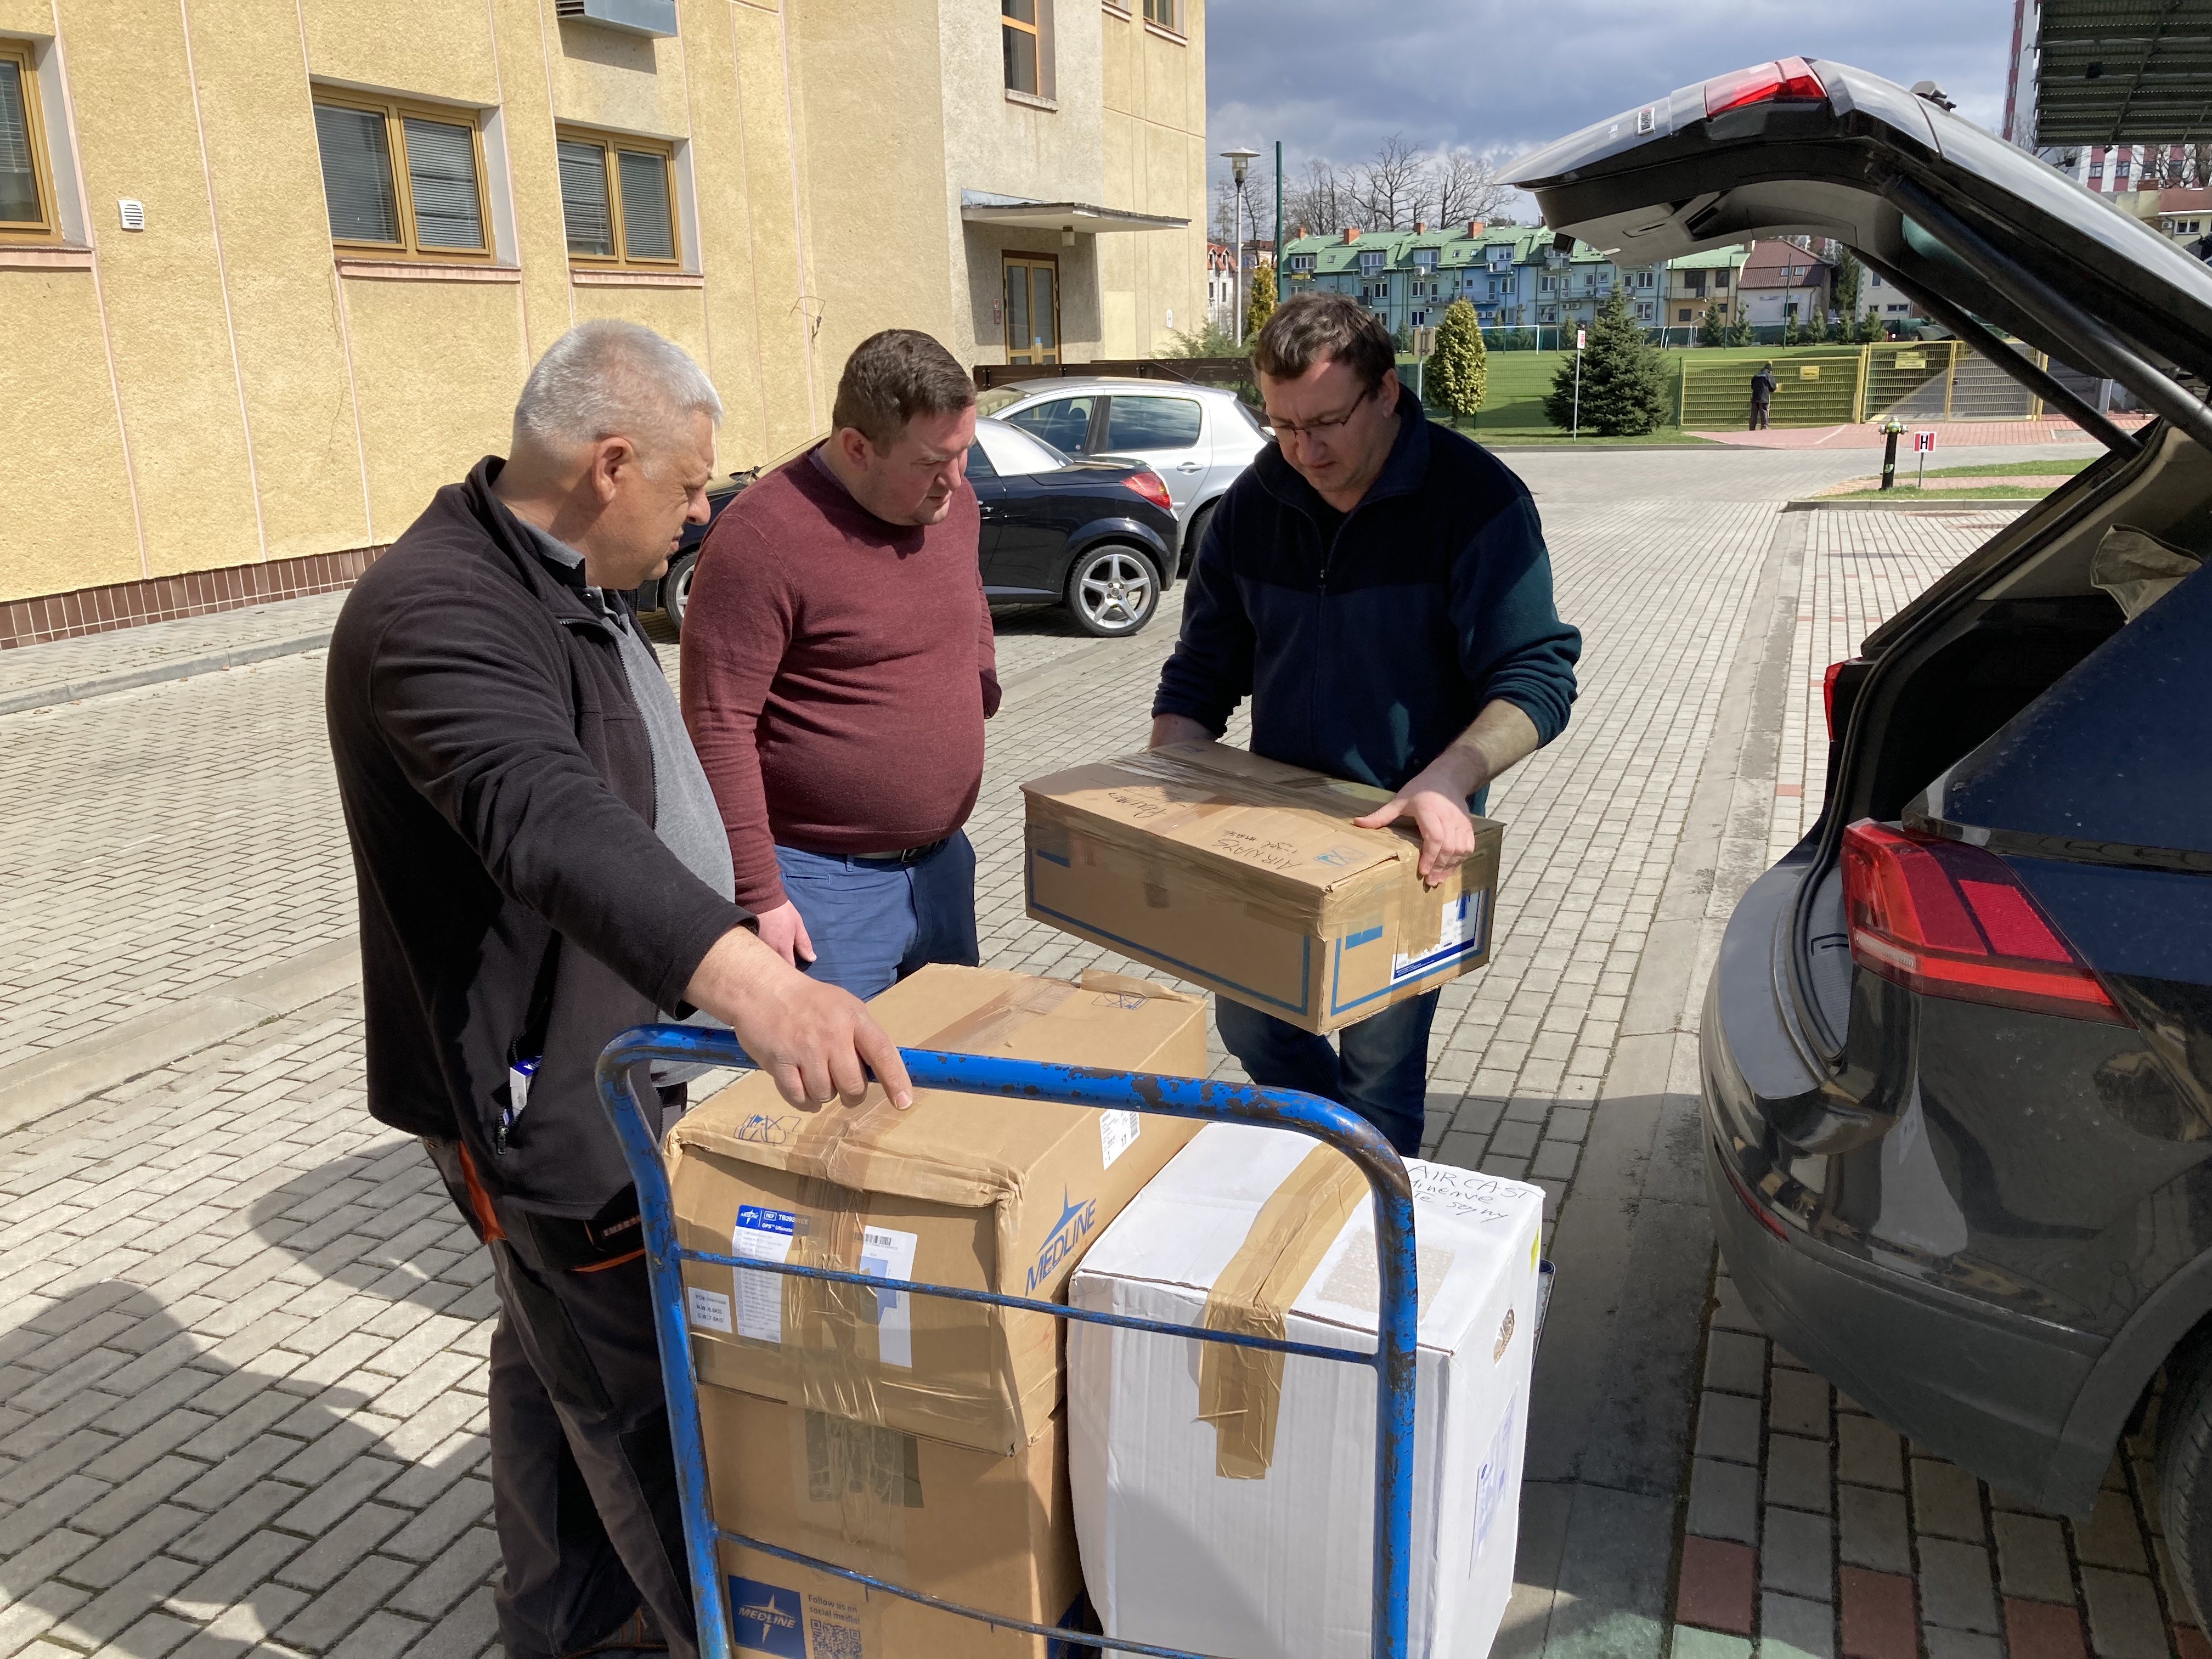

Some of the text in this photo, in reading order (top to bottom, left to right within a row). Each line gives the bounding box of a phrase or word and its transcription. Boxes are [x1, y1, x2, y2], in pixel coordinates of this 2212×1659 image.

[1920, 435, 1928, 449] H
[1025, 1198, 1096, 1298] MEDLINE
[808, 1594, 834, 1607] Follow
[738, 1607, 795, 1629] MEDLINE
[809, 1607, 831, 1617] social
